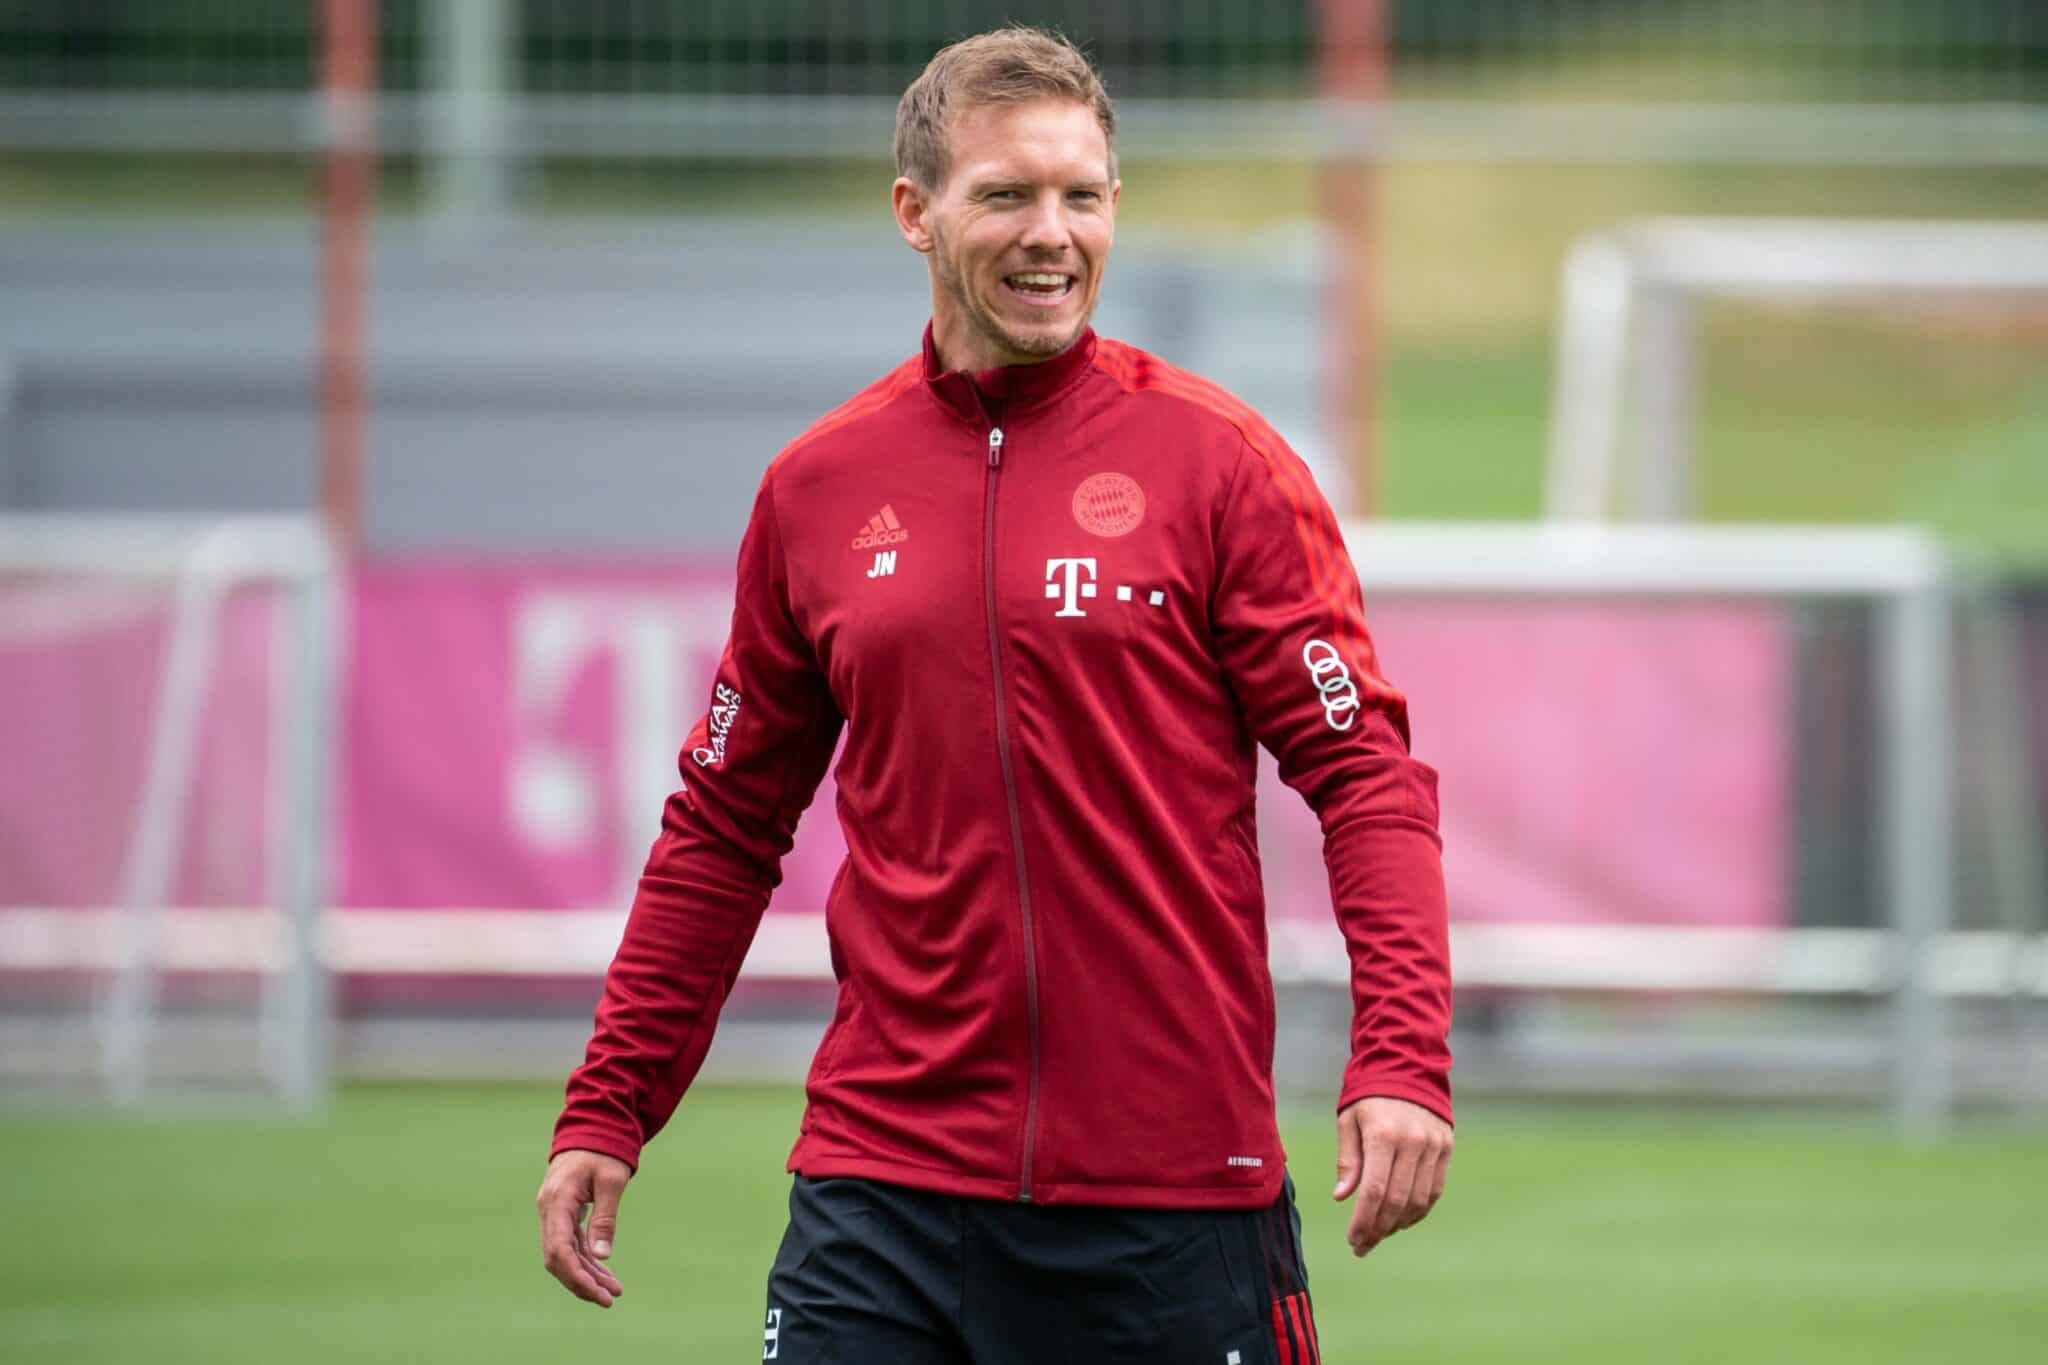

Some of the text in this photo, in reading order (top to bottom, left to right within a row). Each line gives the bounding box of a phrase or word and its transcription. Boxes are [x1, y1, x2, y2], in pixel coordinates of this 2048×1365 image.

[851, 528, 909, 550] adidas
[867, 550, 897, 578] JN
[691, 682, 731, 767] QATAR
